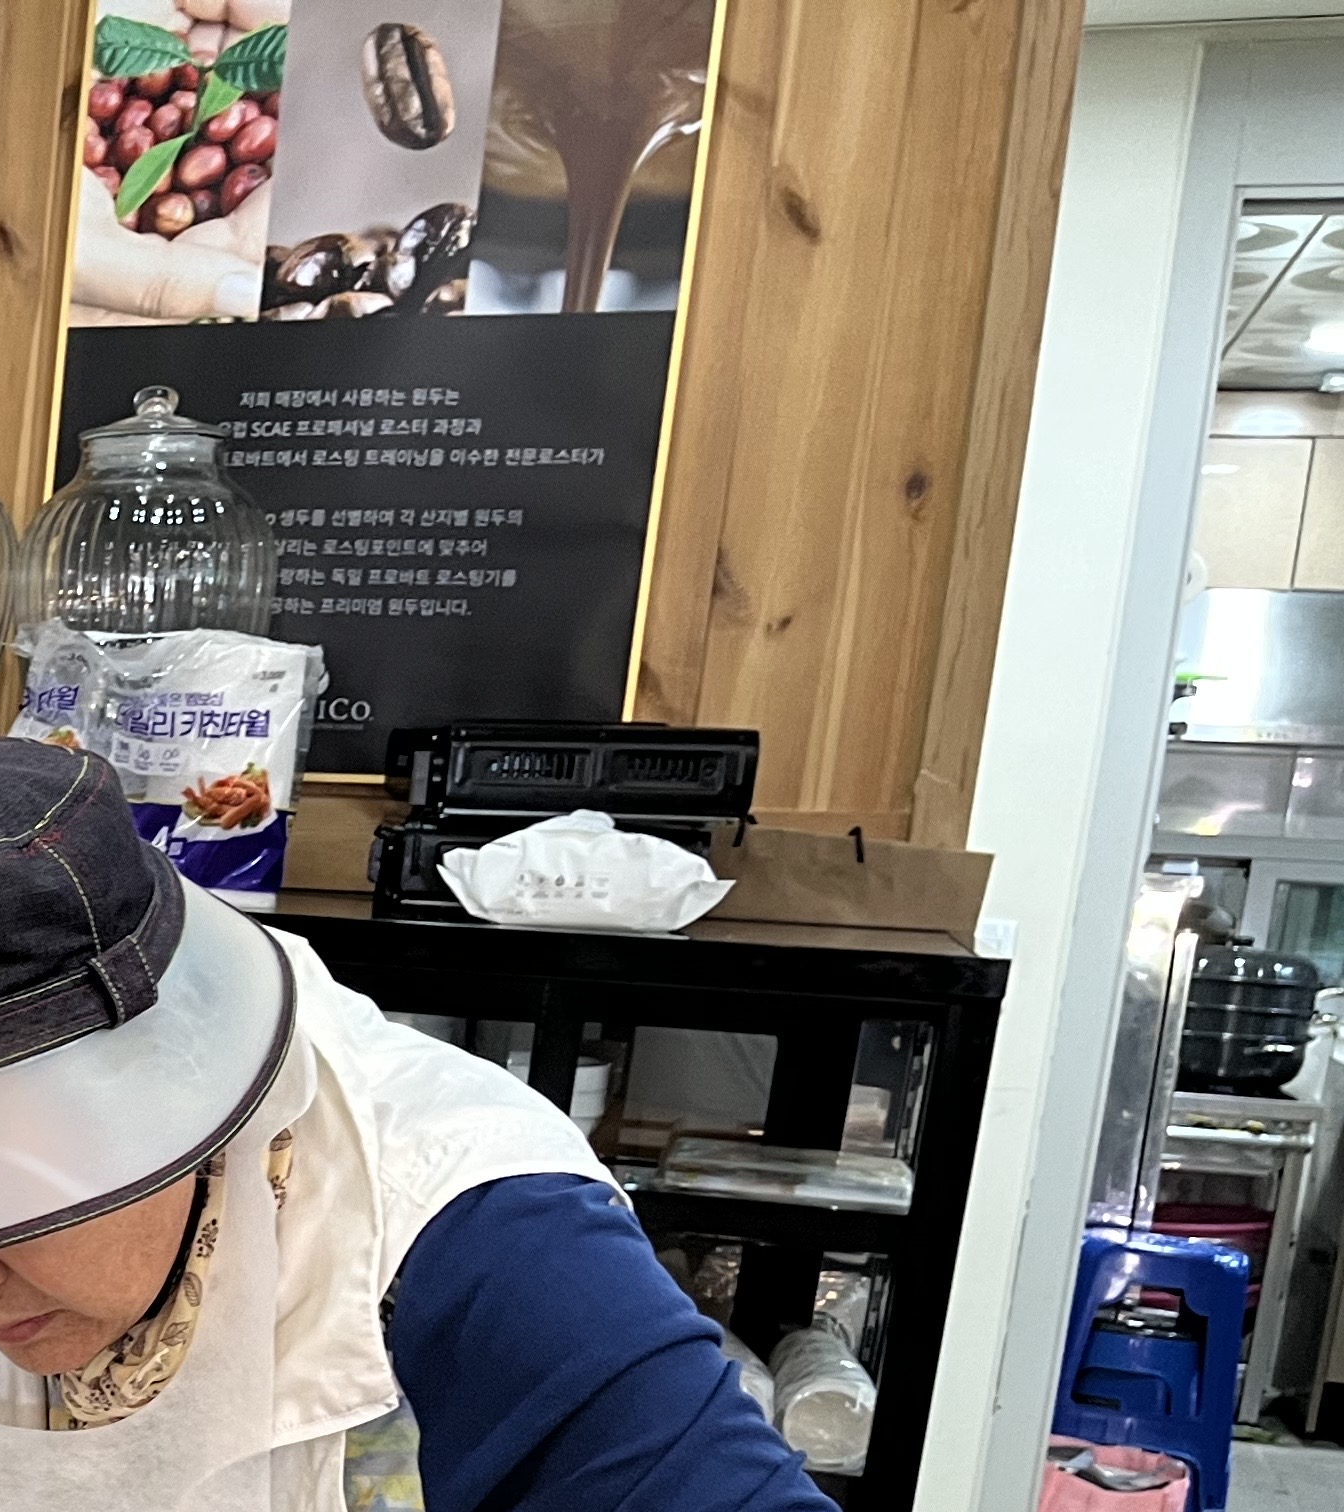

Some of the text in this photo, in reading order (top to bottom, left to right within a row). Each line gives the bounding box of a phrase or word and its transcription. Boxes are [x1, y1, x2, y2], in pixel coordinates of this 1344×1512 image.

[240, 388, 459, 408] 저희 매장에서 사용하는 원두는
[250, 420, 292, 437] SCAE
[378, 418, 428, 436] 로스터
[433, 418, 482, 436] 과정과
[312, 449, 359, 467] 로스팅
[363, 449, 444, 467] 트레이닝을
[449, 448, 499, 467] 이수한
[505, 448, 605, 467] 전문로스터가
[279, 509, 326, 527] 생두를
[332, 509, 395, 527] 선별하여
[400, 509, 415, 527] 각
[420, 509, 469, 527] 산지별
[474, 508, 523, 527] 원두의
[321, 539, 434, 557] 로스팅포인트에
[332, 568, 362, 586] 독일
[368, 569, 431, 586] 프로바트
[435, 568, 517, 587] 로스팅기를
[319, 598, 383, 615] 프리미엄
[388, 598, 472, 616] 원두입니다.
[179, 709, 271, 739] 키친타월
